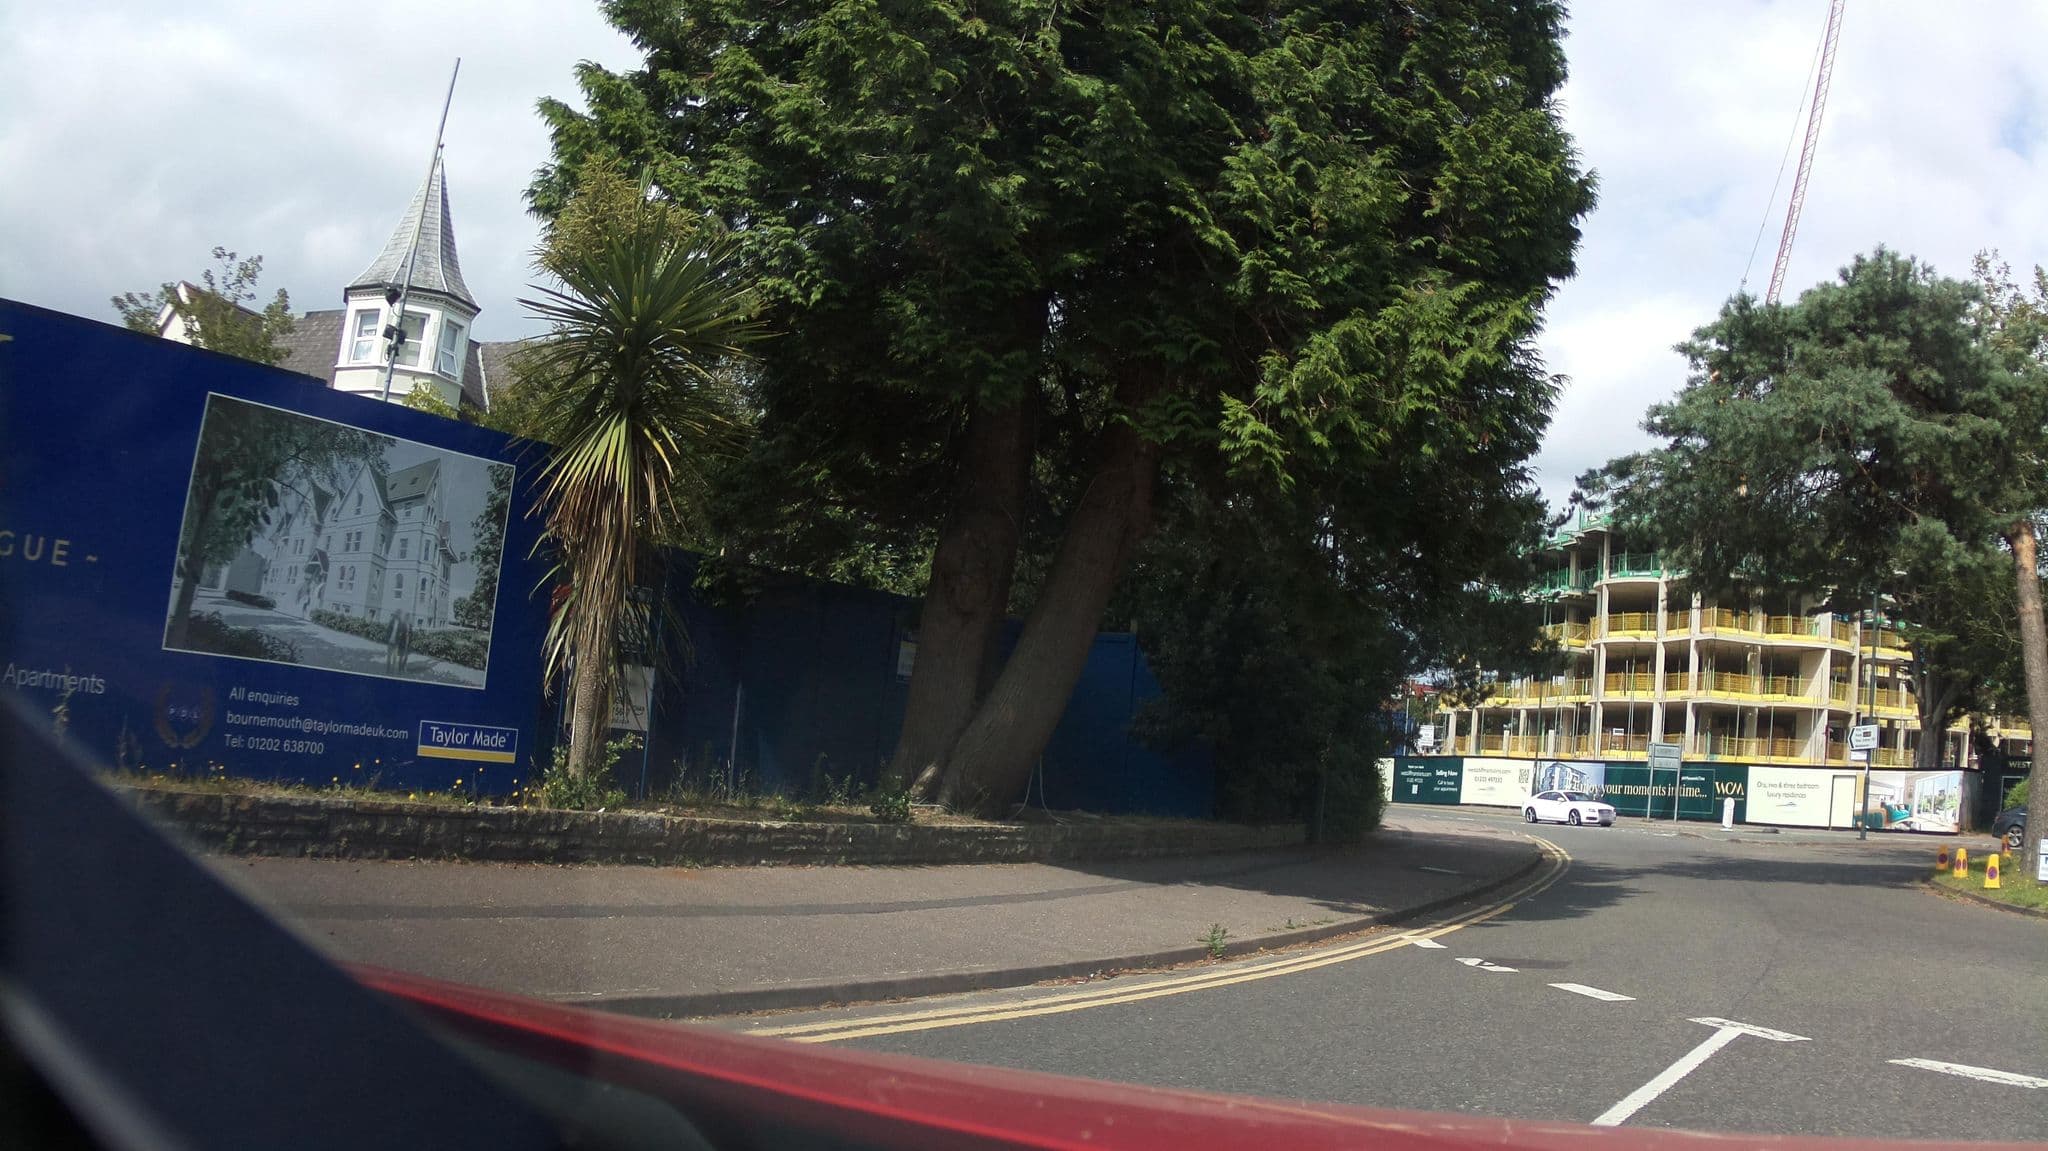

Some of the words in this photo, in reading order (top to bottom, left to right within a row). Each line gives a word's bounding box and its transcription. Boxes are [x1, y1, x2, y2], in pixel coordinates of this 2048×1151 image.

[0, 531, 71, 566] GUE
[3, 662, 105, 694] Apartments
[229, 687, 245, 701] All
[248, 692, 299, 706] enquiries
[226, 710, 408, 740] bournemouth@taylormadeuk.com
[224, 734, 244, 748] Tel:
[248, 736, 280, 752] 01202
[283, 739, 324, 755] 638700
[430, 726, 469, 746] Taylor
[472, 731, 507, 748] Made
[1602, 784, 1623, 797] your
